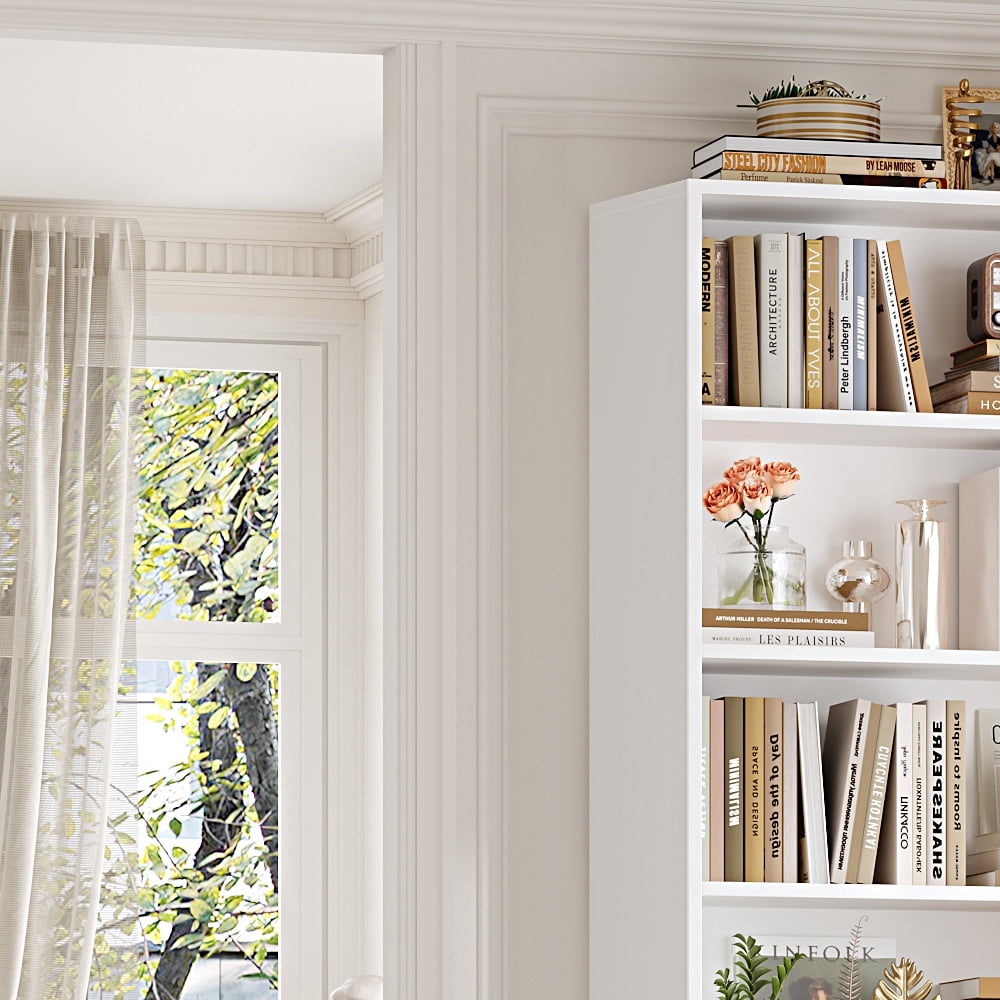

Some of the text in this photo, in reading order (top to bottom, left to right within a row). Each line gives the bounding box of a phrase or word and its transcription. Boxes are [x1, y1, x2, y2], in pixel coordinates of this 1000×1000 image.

[724, 152, 826, 173] STEEL CITY FASHION
[741, 173, 768, 182] Perfume
[866, 160, 916, 172] BY LEAH MOOSE
[702, 248, 711, 312] MODERN
[769, 268, 778, 356] ARCHITECTURE
[808, 247, 821, 389] ALL ABOUT YVES
[856, 296, 865, 361] MINIMALISM
[841, 316, 851, 394] Peter Lindbergh
[759, 634, 846, 646] LES PLAISIRS
[754, 944, 875, 962] INFOK
